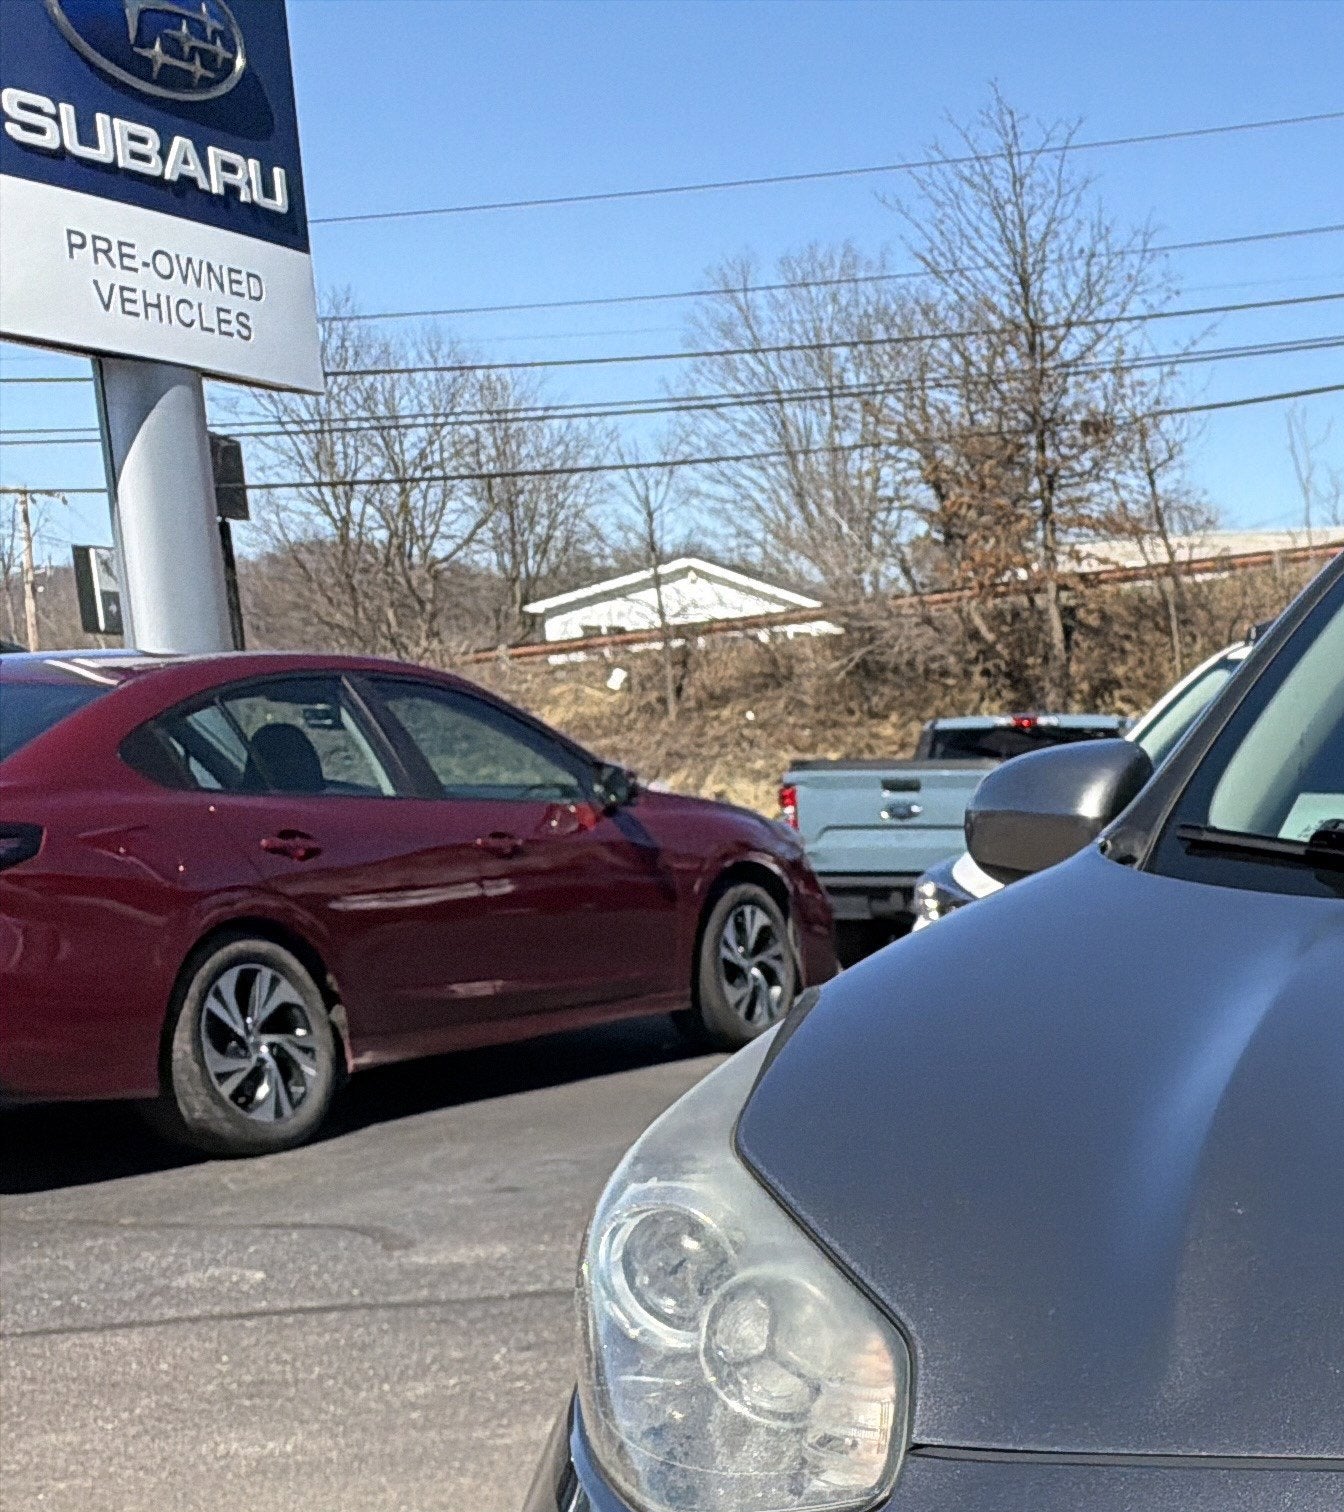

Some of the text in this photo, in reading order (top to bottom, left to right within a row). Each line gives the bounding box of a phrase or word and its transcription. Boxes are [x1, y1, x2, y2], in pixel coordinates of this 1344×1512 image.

[1, 87, 289, 214] SUBARU
[65, 227, 265, 302] PRE-OWNED
[92, 278, 253, 341] VEHICLES
